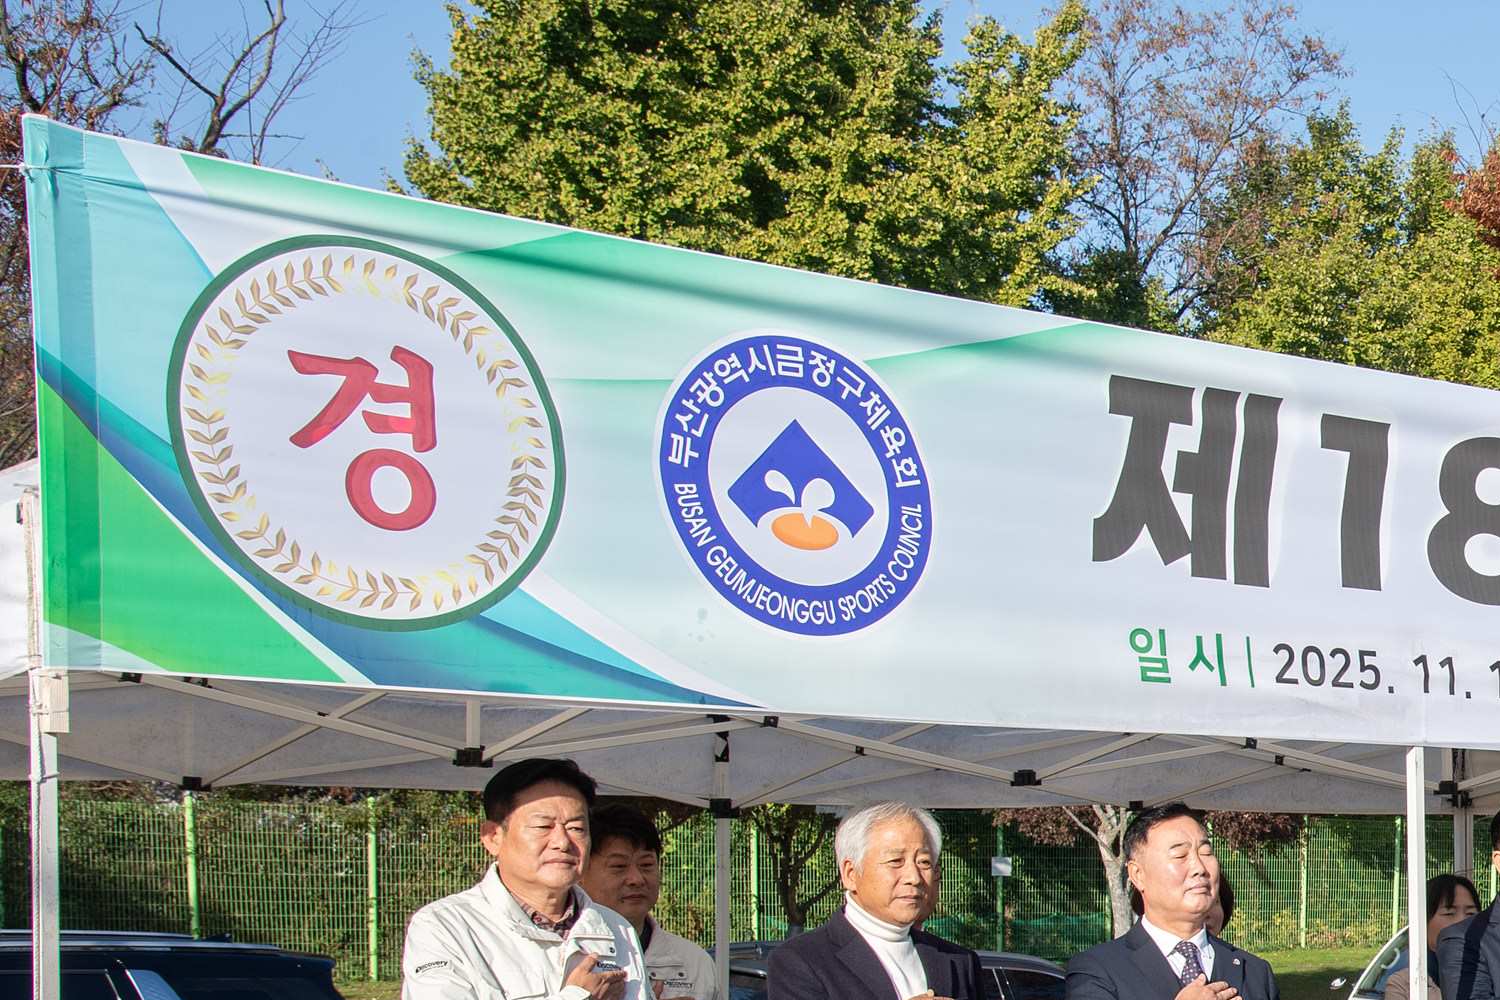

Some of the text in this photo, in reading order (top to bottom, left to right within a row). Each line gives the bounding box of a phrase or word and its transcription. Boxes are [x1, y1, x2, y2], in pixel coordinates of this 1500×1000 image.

[288, 345, 436, 532] 경
[674, 483, 923, 625] BUSAN GEUMJEONGGU SPORTS COUNCIL
[1272, 643, 1395, 694] 2025.
[1412, 654, 1472, 699] 11.
